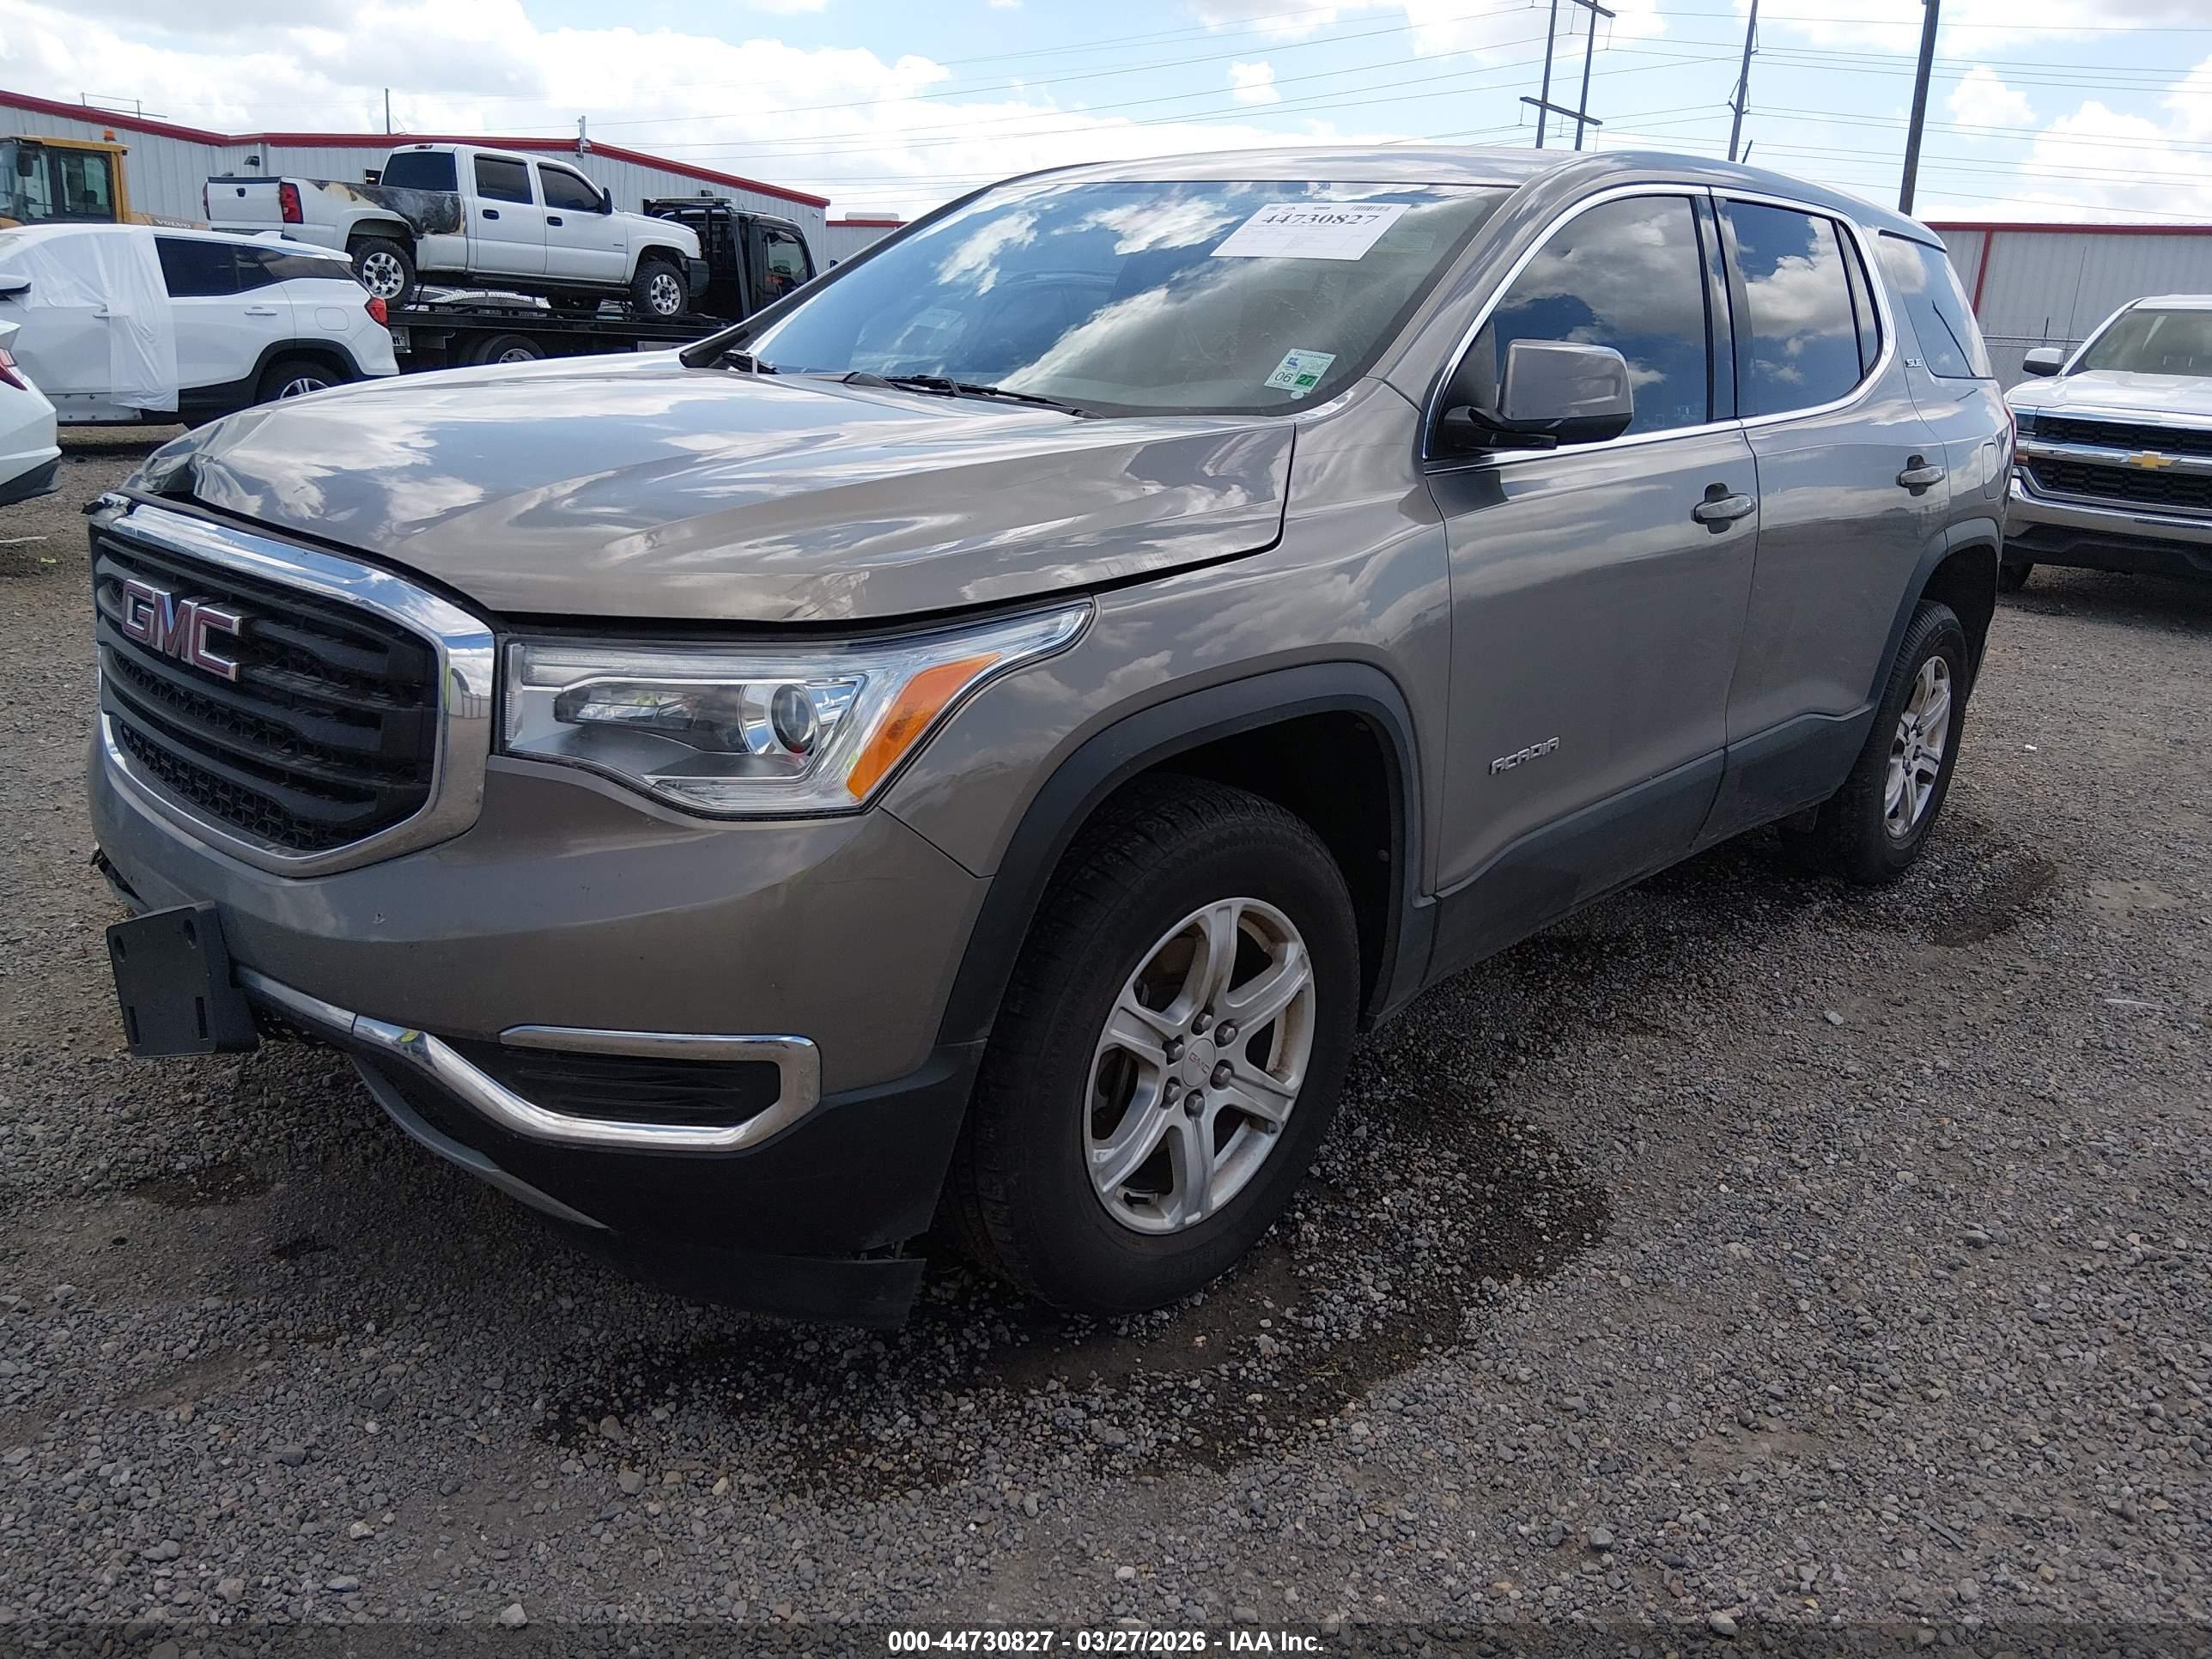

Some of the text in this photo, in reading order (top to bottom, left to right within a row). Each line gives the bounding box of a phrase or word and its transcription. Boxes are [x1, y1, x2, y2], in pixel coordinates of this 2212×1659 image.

[155, 218, 191, 228] VOLVO
[1261, 213, 1380, 225] 44730827
[1274, 371, 1318, 386] 06 27
[122, 579, 241, 683] GMC
[1490, 737, 1559, 775] ACADIA
